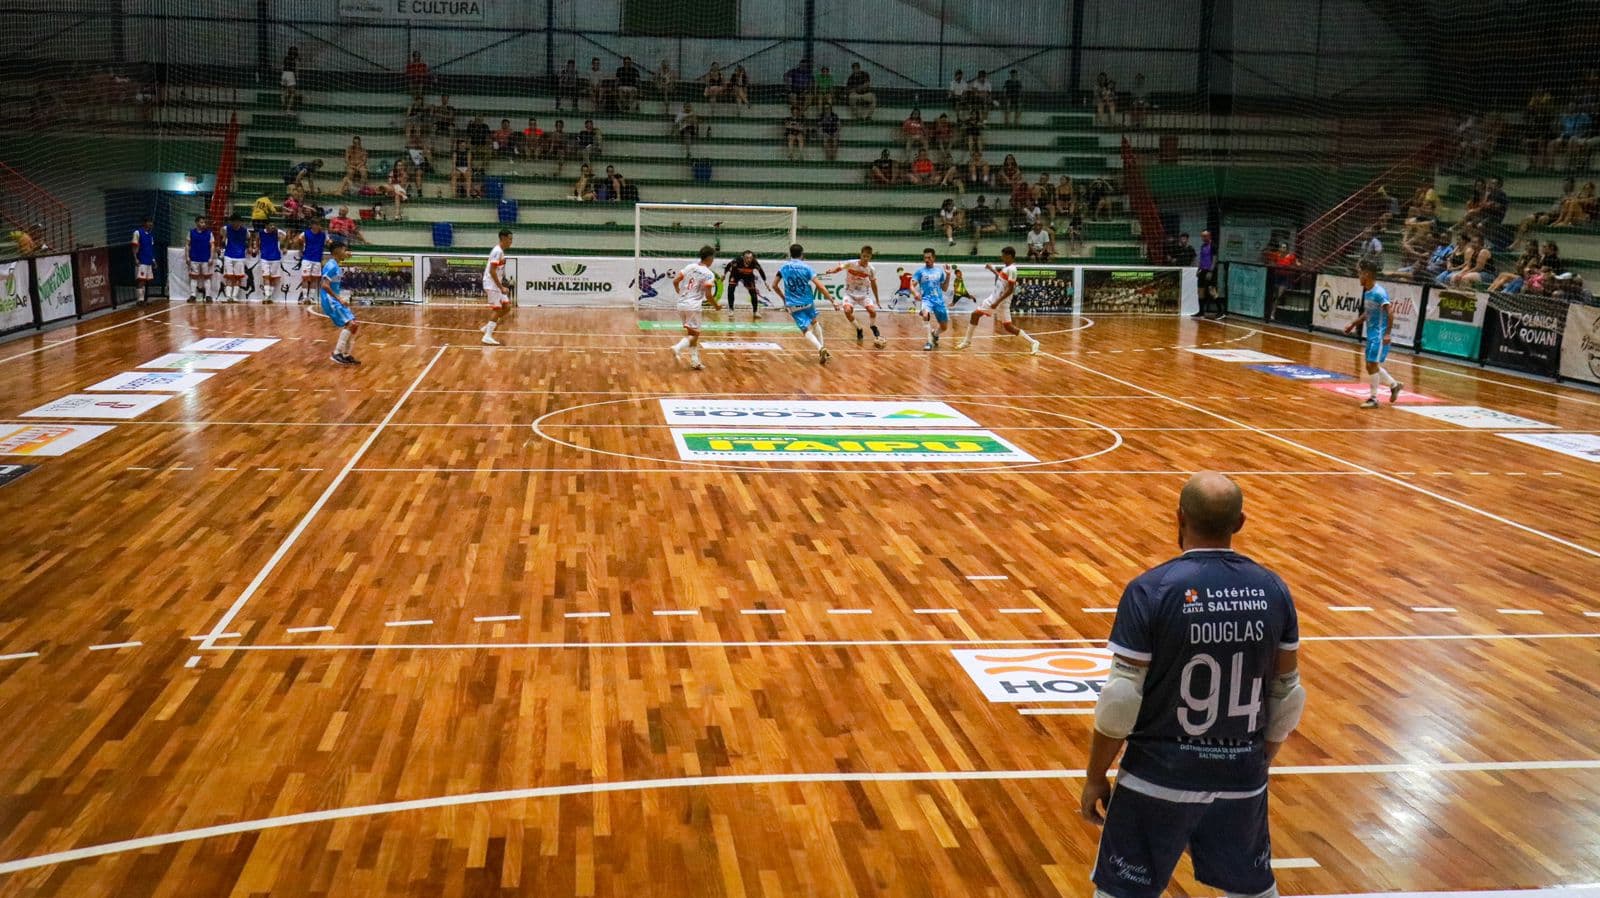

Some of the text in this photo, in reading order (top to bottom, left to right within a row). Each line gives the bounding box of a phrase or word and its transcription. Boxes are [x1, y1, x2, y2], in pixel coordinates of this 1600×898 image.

[412, 0, 481, 15] CULTURA
[525, 281, 613, 292] PINHALZINHO
[1519, 328, 1557, 346] ROVANI
[672, 410, 878, 418] SICOOB
[708, 440, 984, 453] ITAIPU
[1206, 587, 1266, 598] Lotérica
[1208, 600, 1268, 612] SALTINHO
[1190, 620, 1265, 644] DOUGLAS
[1176, 652, 1263, 736] 94
